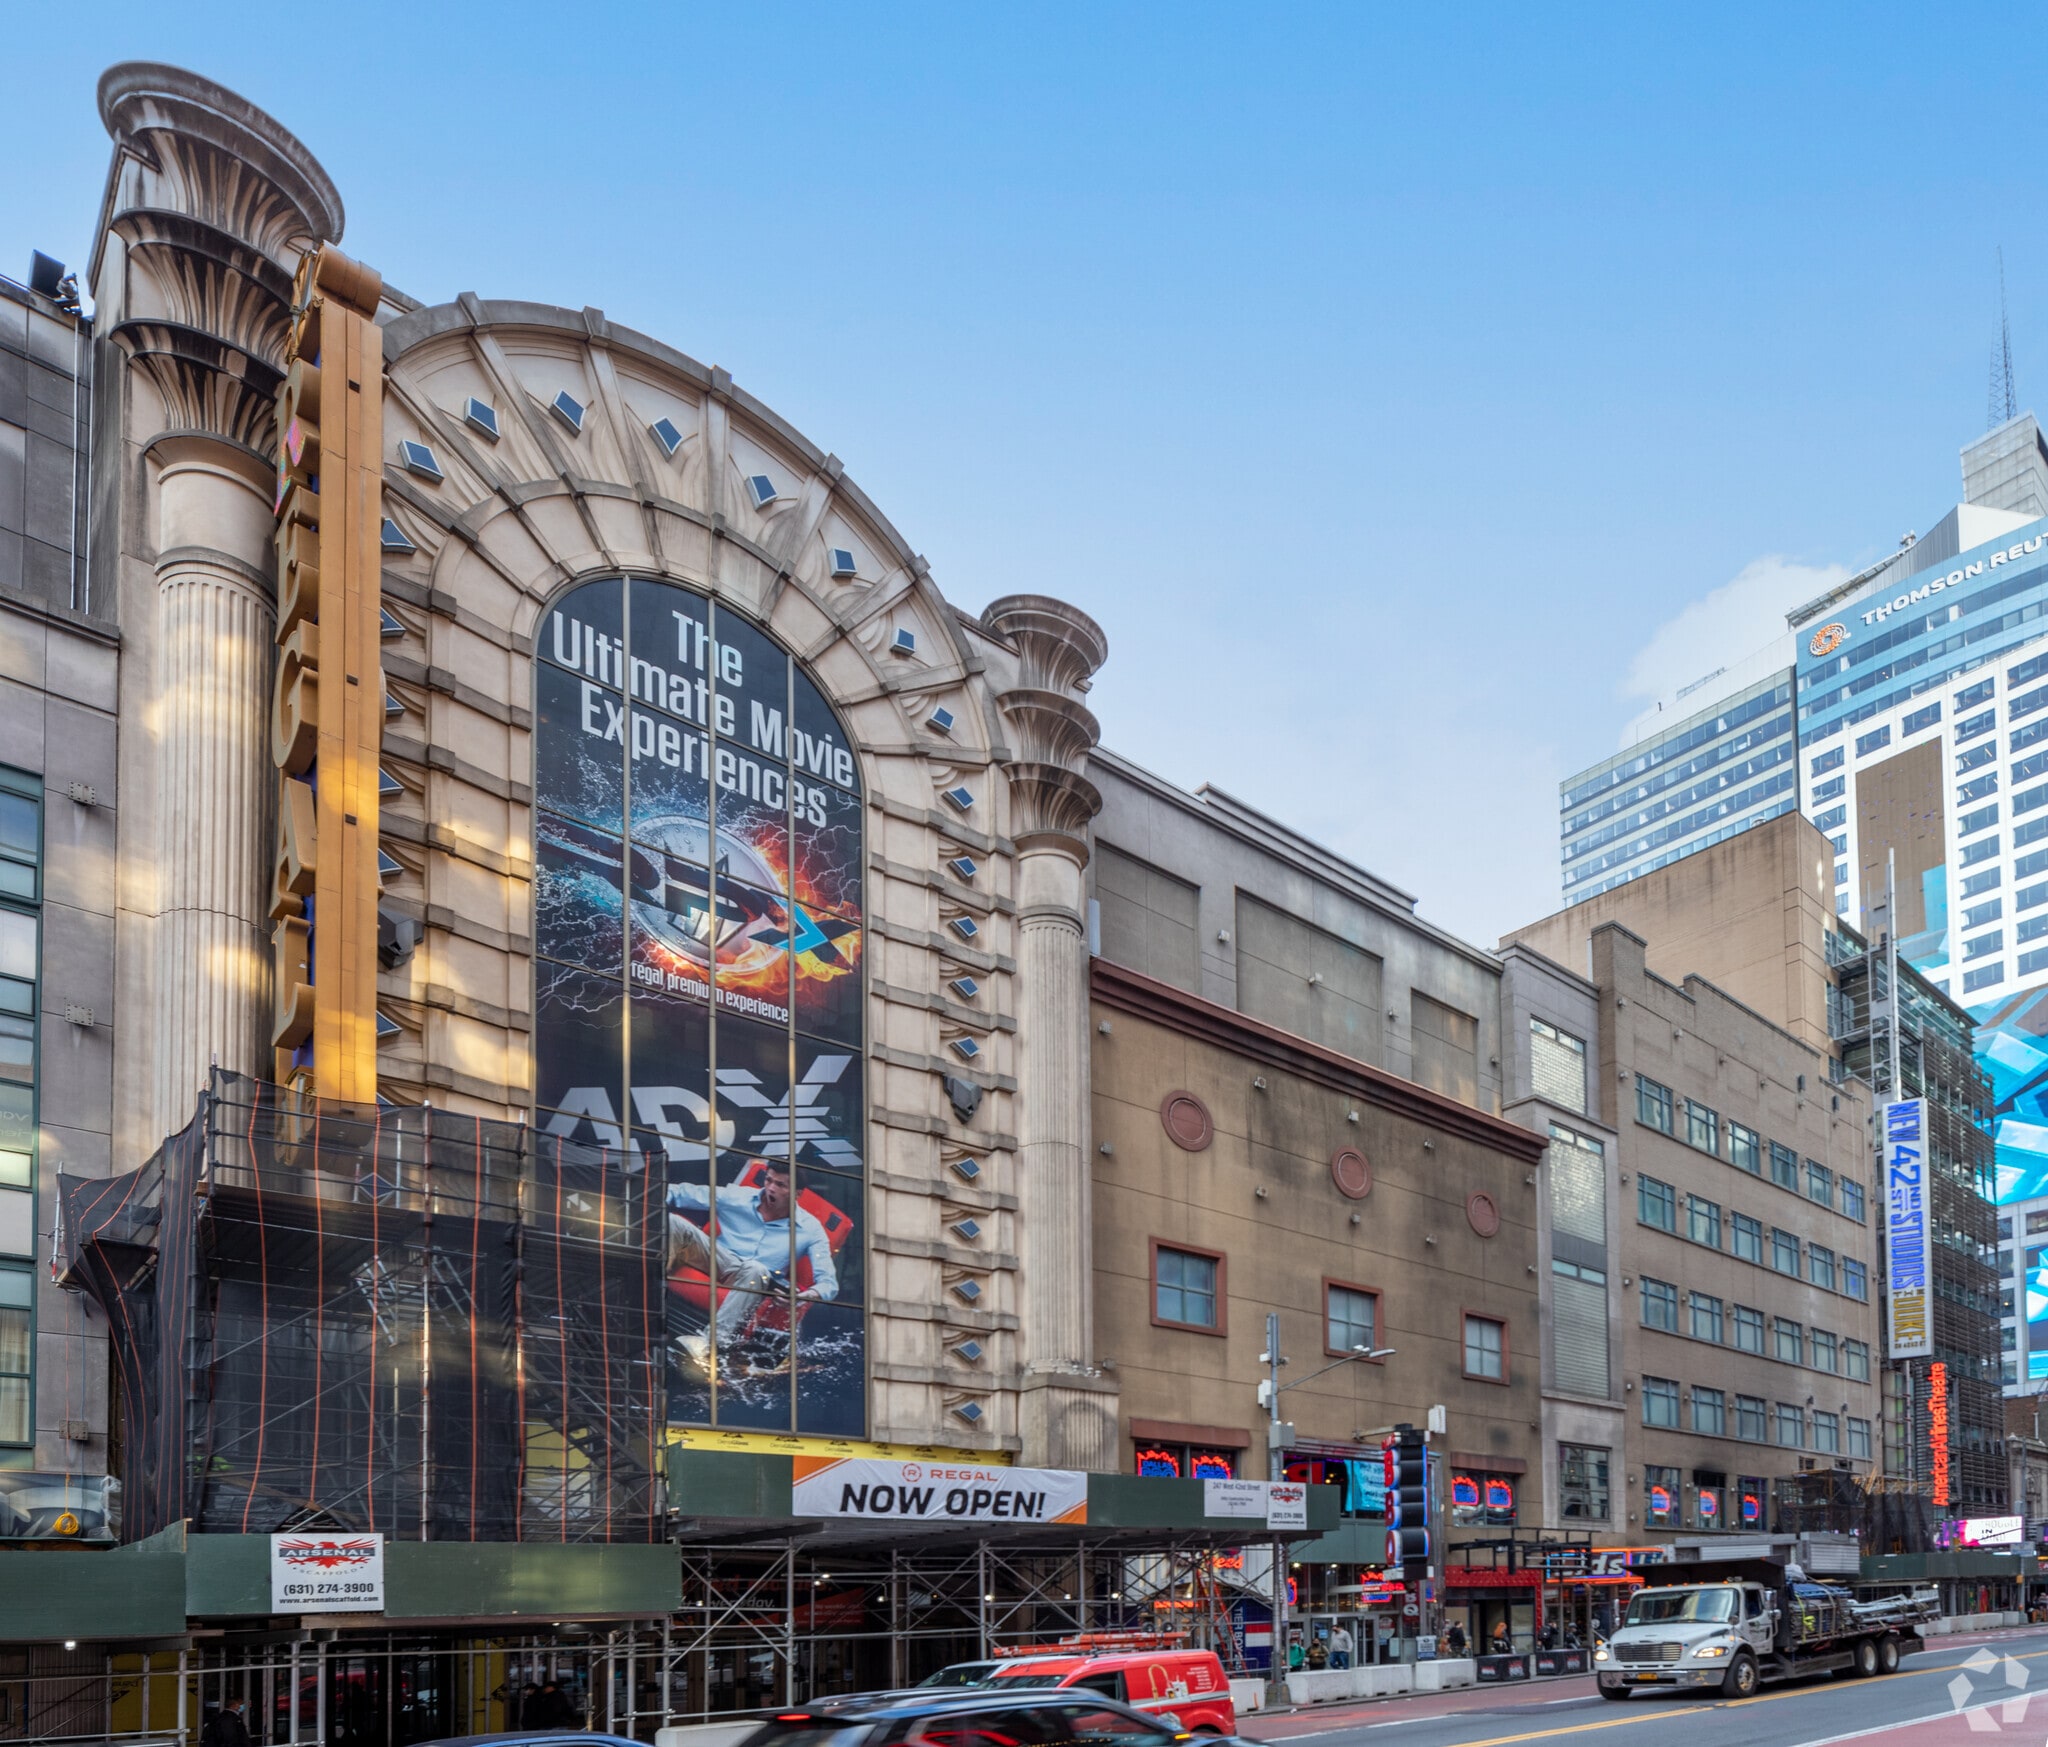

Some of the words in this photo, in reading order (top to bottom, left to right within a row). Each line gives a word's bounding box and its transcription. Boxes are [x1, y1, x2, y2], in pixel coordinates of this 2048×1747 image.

[1861, 560, 1984, 626] THOMSON
[672, 610, 743, 687] The
[553, 610, 735, 737] Ultimate
[750, 699, 853, 787] Movie
[580, 680, 828, 828] Experiences
[631, 961, 664, 986] regal
[667, 972, 723, 1003] premium
[725, 988, 789, 1023] experience
[1887, 1101, 1920, 1142] NEW
[1890, 1210, 1925, 1290] STUDIOS
[1893, 1295, 1926, 1342] DUKE
[930, 1469, 998, 1482] REGAL
[839, 1483, 935, 1515] NOW
[945, 1488, 1046, 1518] OPEN!
[284, 1584, 314, 1596] (631)
[317, 1583, 374, 1594] 274-3900
[299, 1568, 358, 1576] SCAFFOLD
[279, 1595, 379, 1604] www.arsenalscaffold.com
